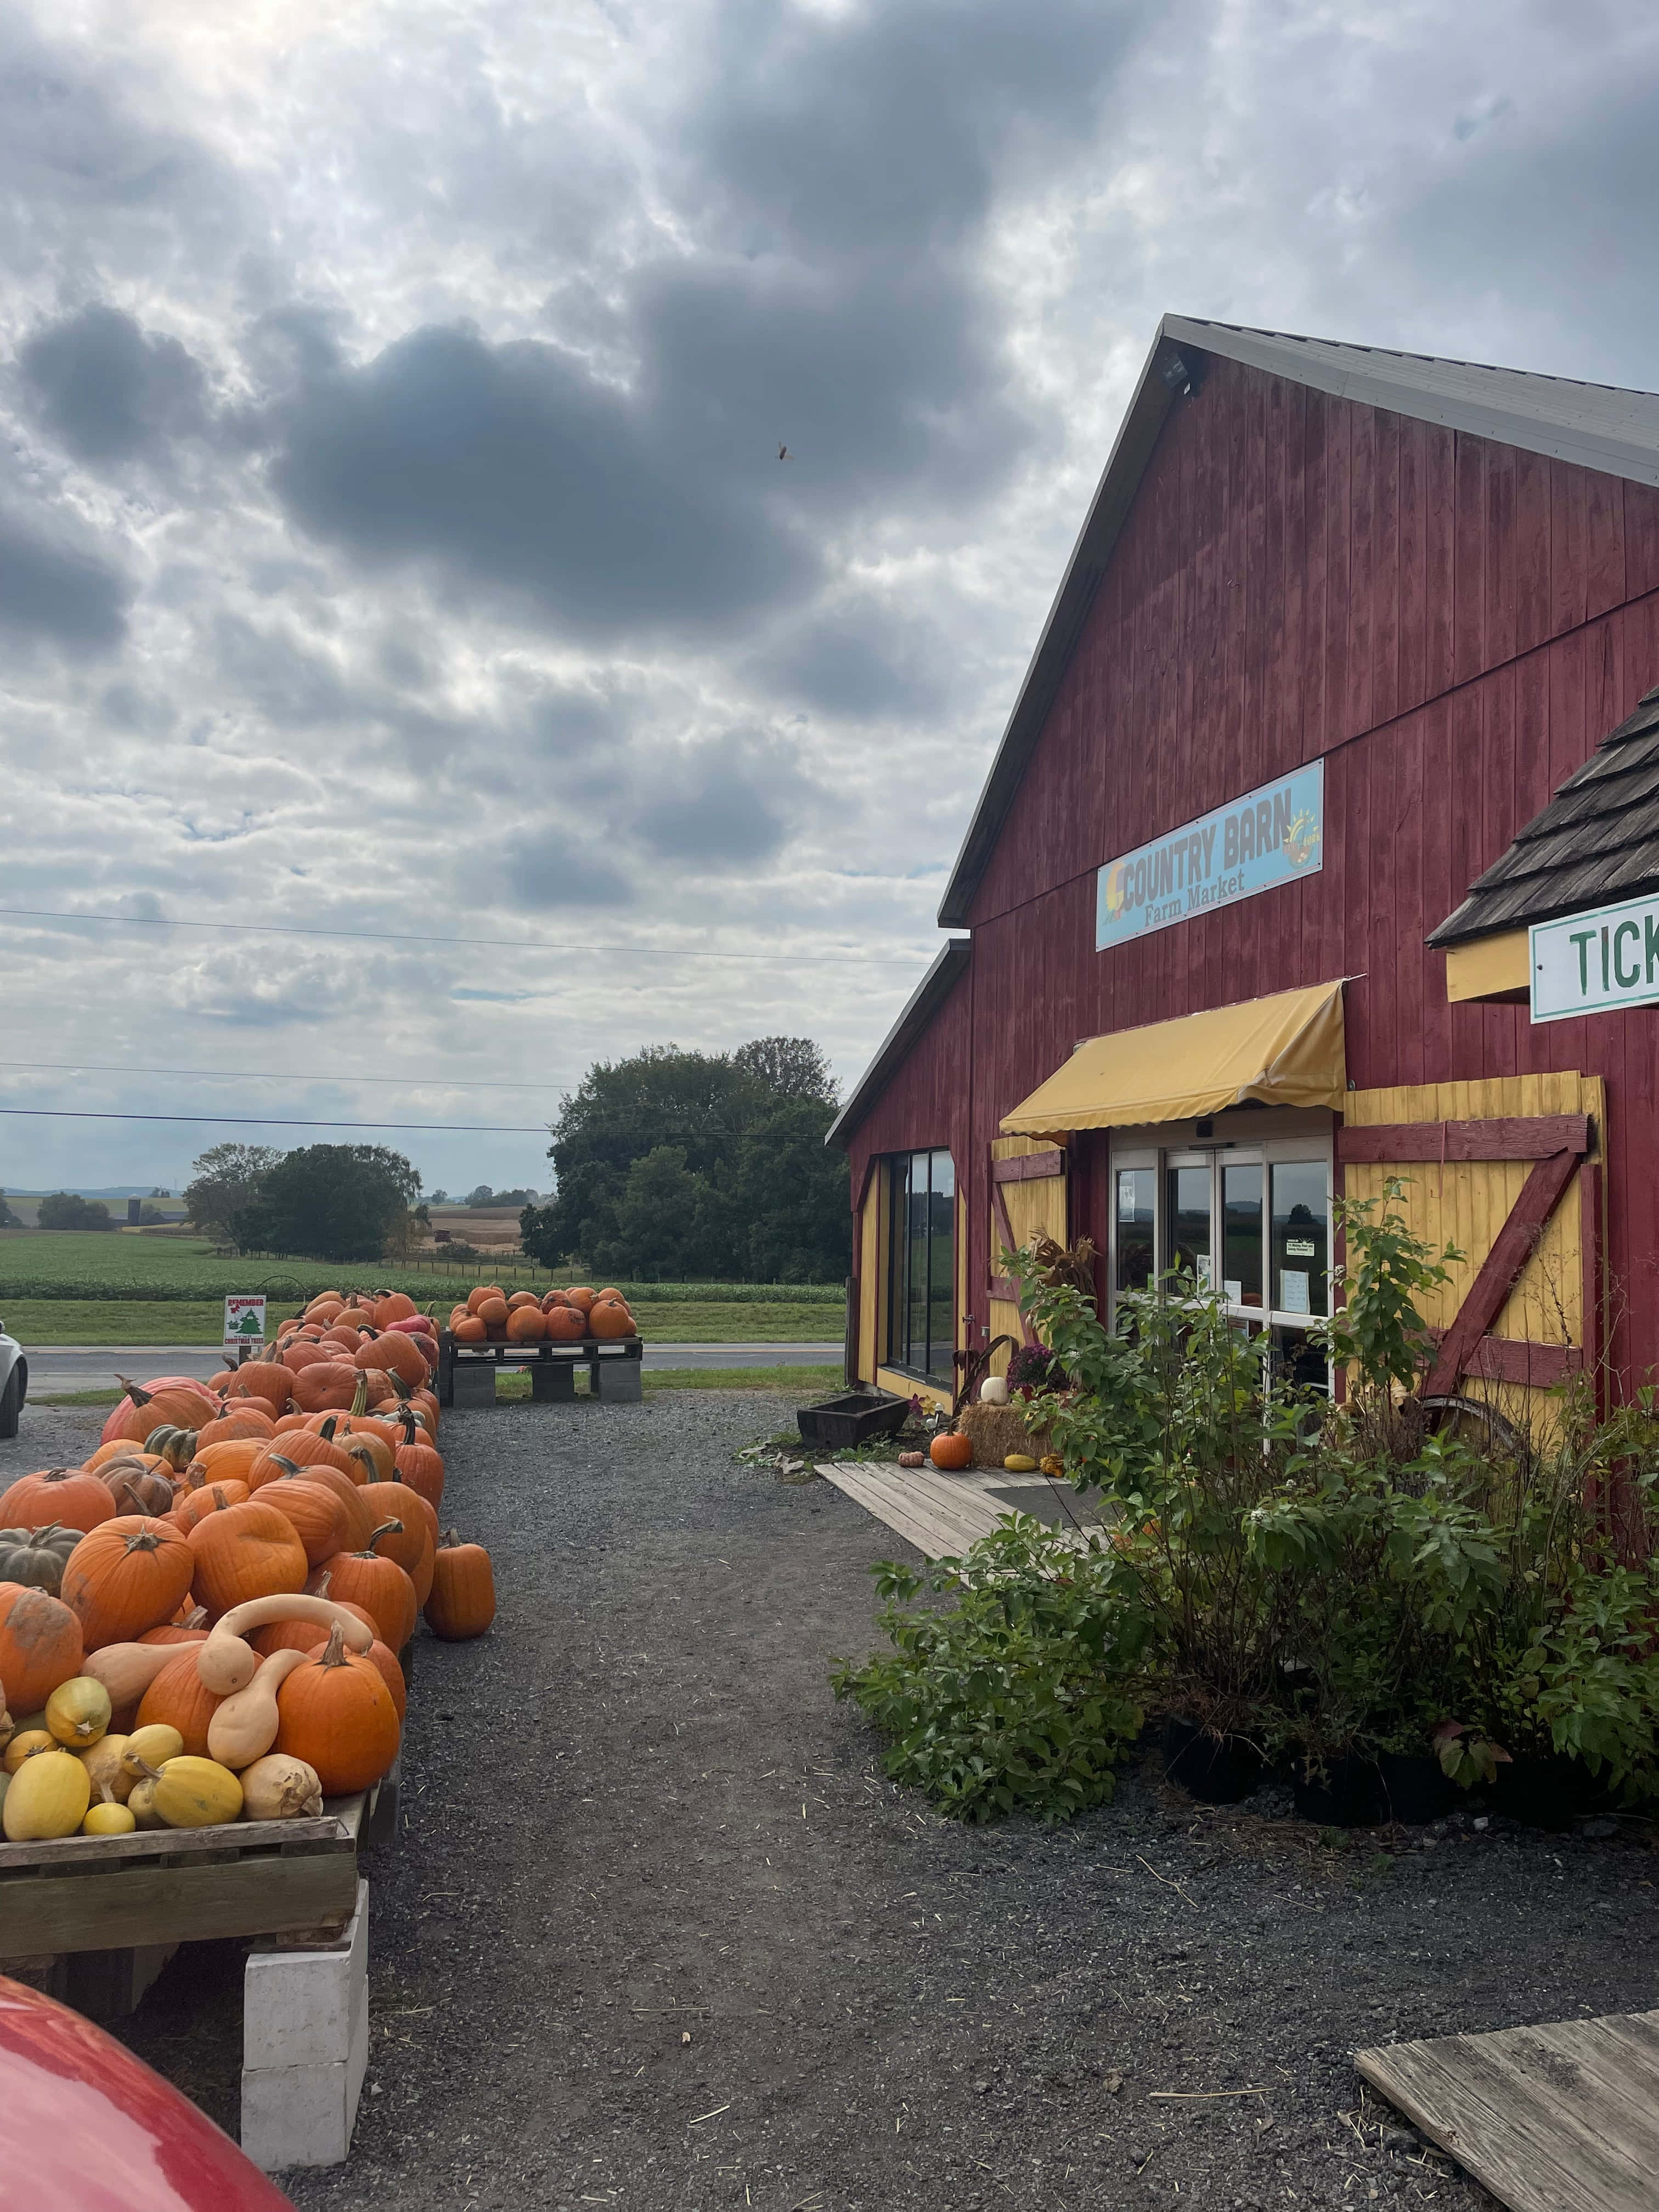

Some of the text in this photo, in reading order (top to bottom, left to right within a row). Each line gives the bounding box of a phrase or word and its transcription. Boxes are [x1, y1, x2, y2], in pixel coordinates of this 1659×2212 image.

[1124, 787, 1291, 912] COUNTRY BARN
[1145, 868, 1245, 928] Farm Market
